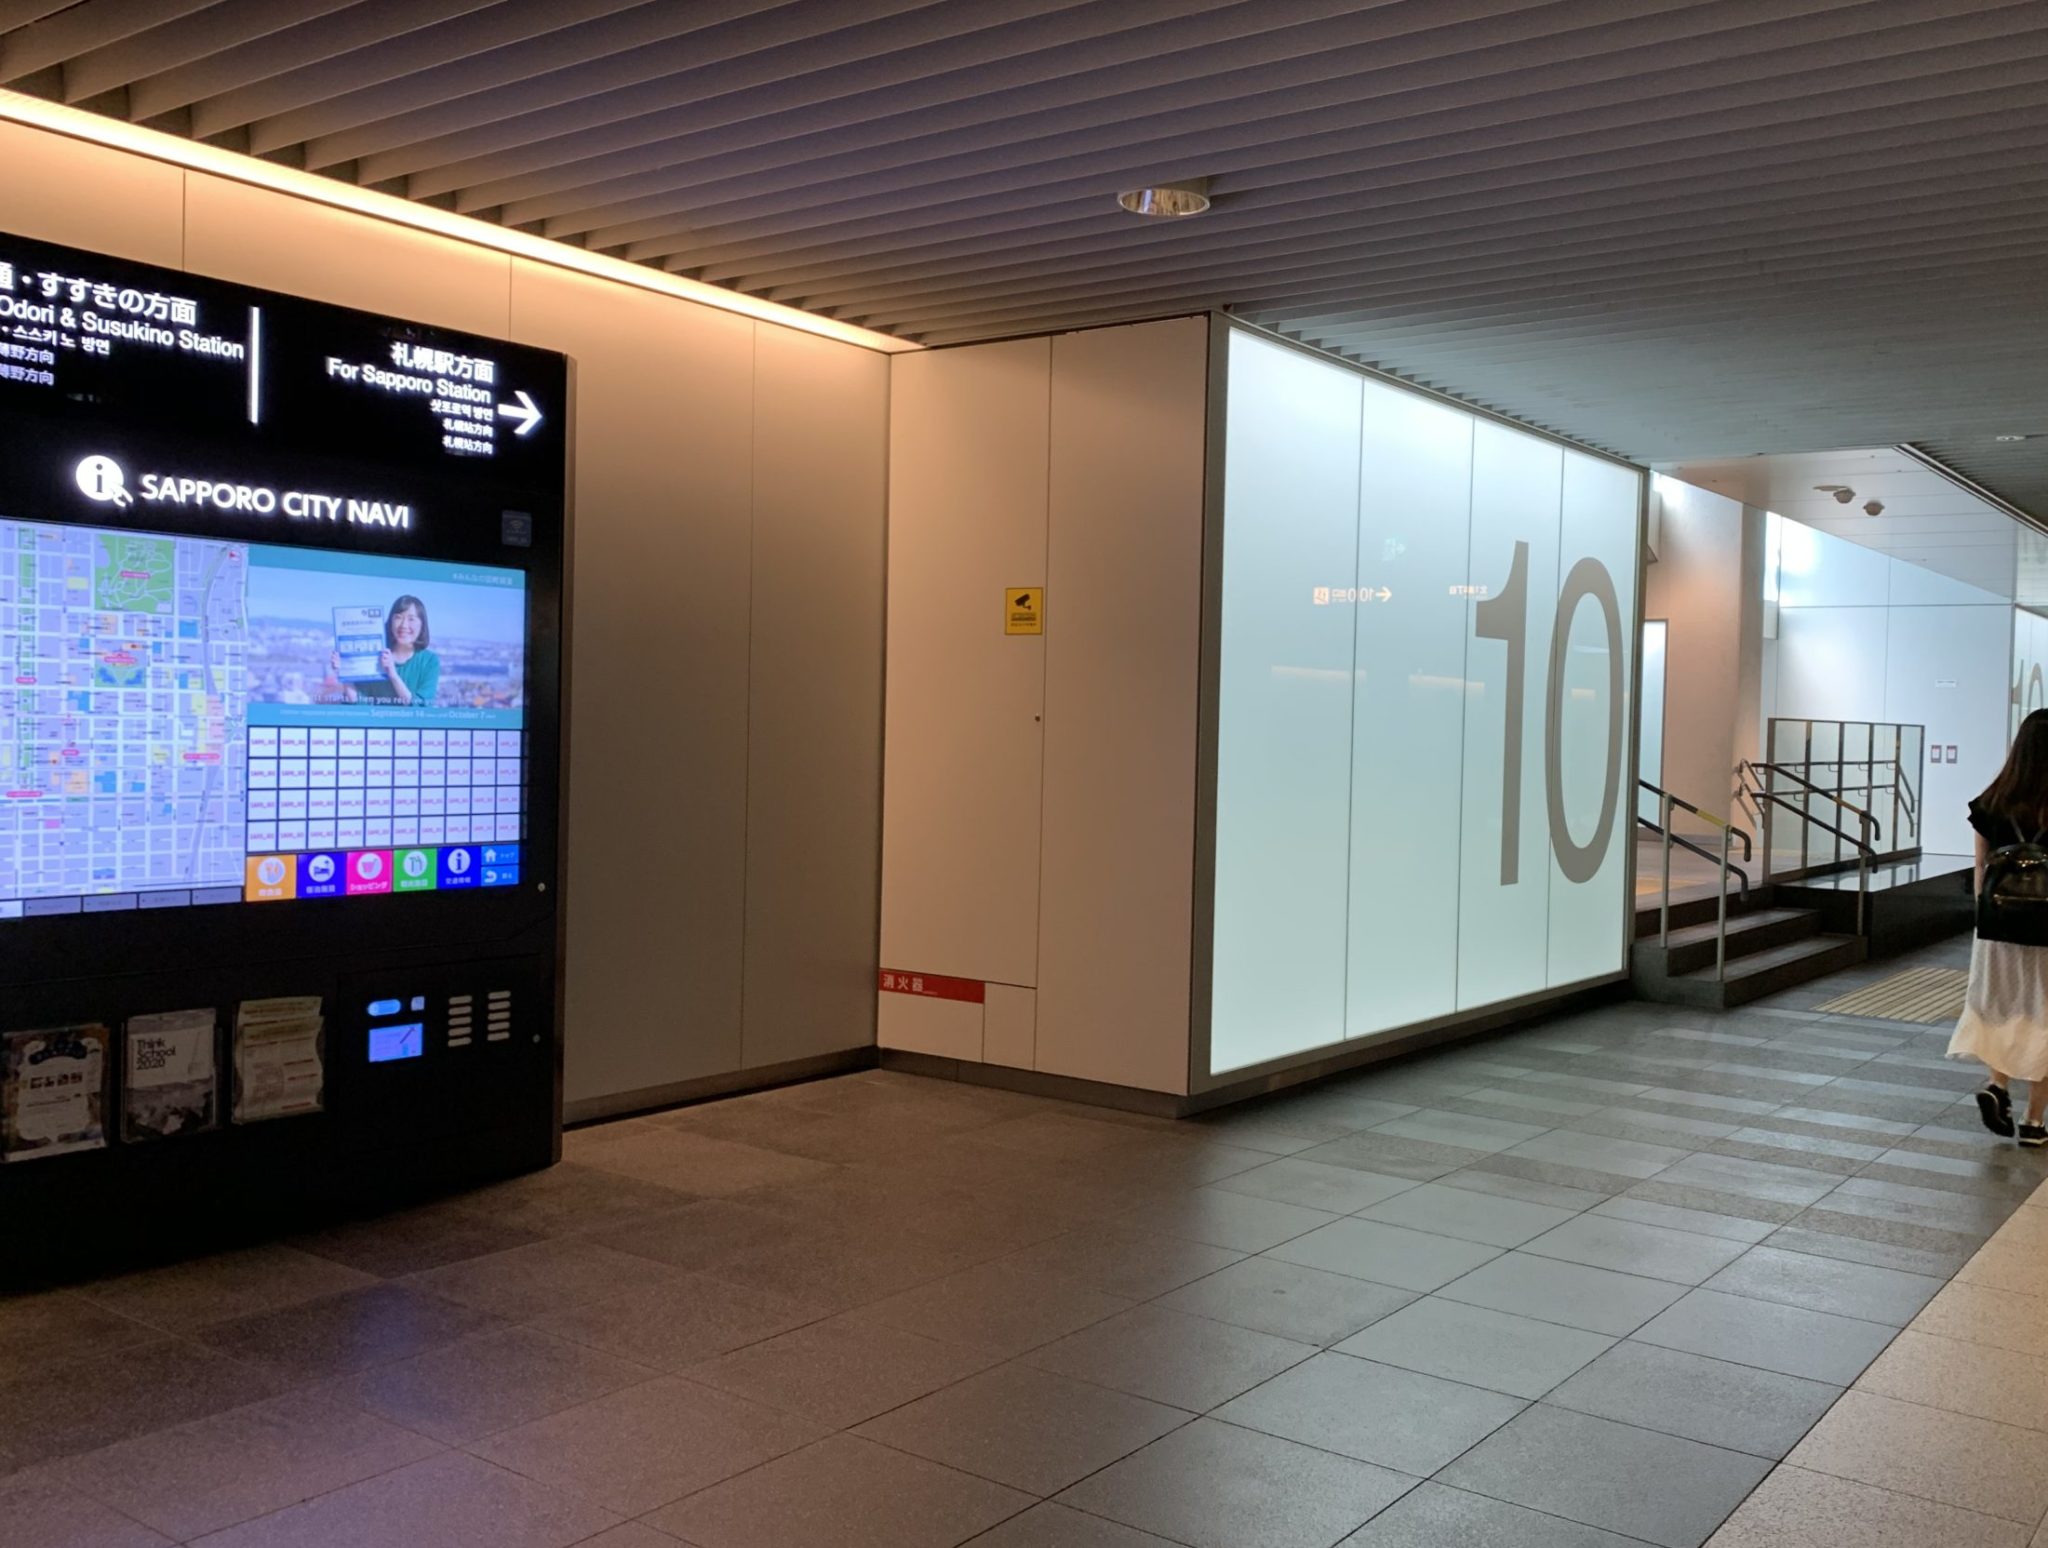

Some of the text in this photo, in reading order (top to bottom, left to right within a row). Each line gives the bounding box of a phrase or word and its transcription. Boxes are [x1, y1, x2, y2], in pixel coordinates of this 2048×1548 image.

[0, 295, 244, 360] Odori & Susukino Station
[327, 356, 491, 404] For Sapporo Station
[391, 342, 494, 384] 札幌駅方面
[140, 473, 409, 529] SAPPORO CITY NAVI
[1476, 541, 1625, 886] 10
[883, 974, 923, 992] 消火器
[136, 1057, 165, 1070] 2020
[137, 1038, 166, 1050] Think
[137, 1046, 176, 1058] School
